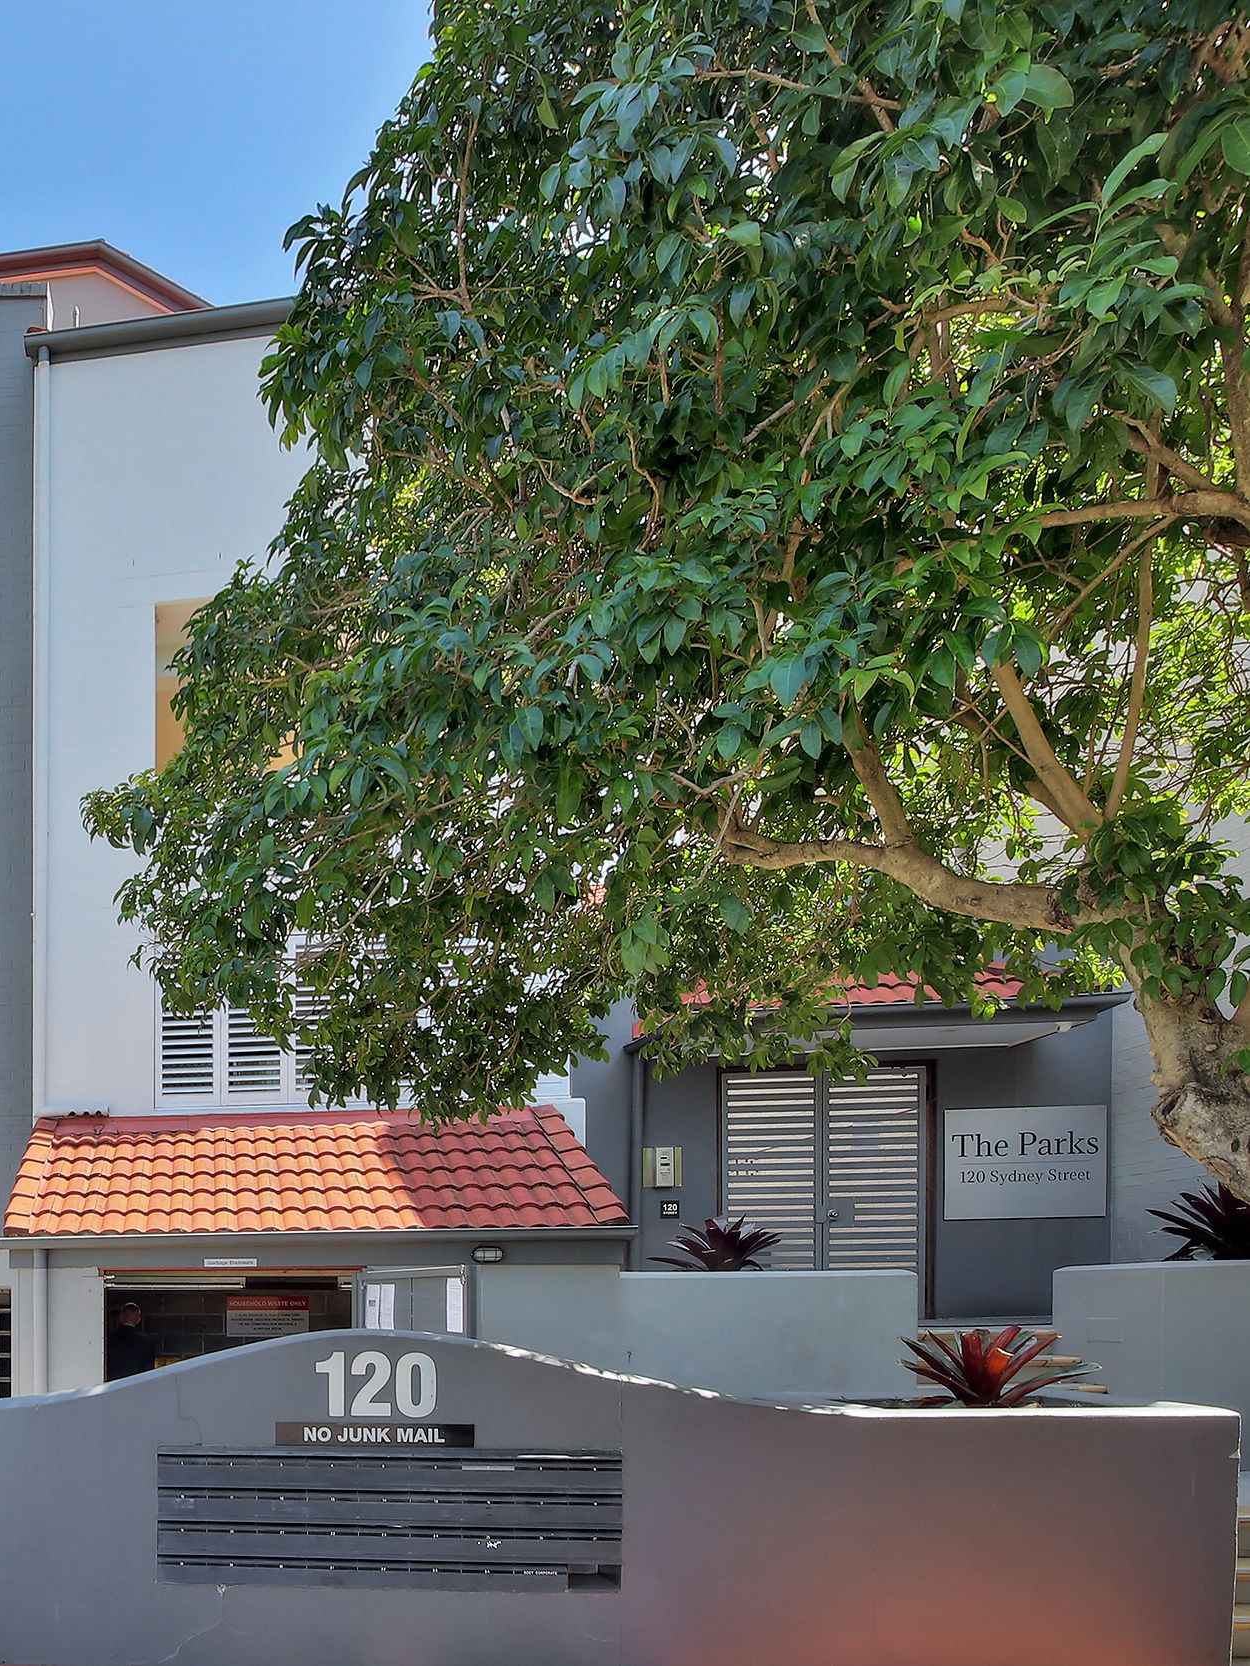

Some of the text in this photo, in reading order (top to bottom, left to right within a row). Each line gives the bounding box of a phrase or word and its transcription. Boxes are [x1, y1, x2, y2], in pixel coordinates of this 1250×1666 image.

[951, 1130, 1099, 1158] The Parks
[960, 1168, 1091, 1186] 120 Sydney Street
[662, 1203, 678, 1211] 120
[315, 1350, 438, 1418] 120
[303, 1426, 446, 1444] NO JUNK MAIL
